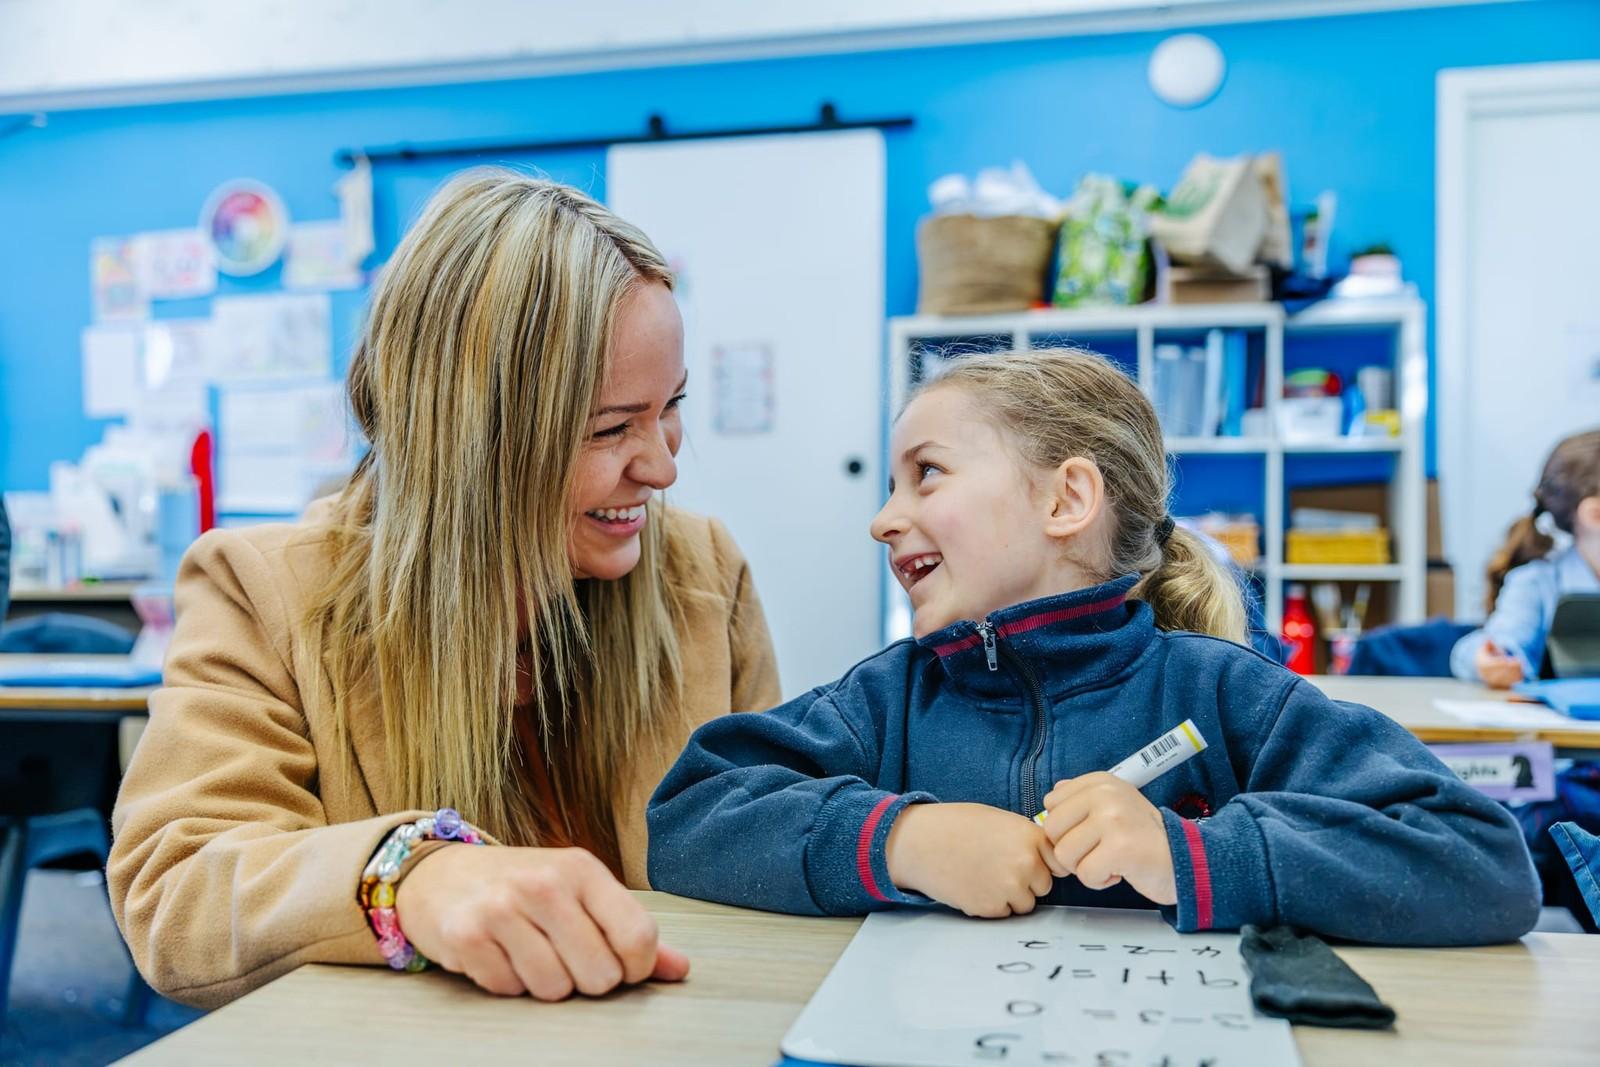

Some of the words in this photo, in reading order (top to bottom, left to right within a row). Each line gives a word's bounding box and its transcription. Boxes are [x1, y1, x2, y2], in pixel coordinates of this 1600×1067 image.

[1196, 969, 1239, 988] 9
[1005, 1000, 1044, 1018] 0
[973, 1033, 1023, 1060] 5
